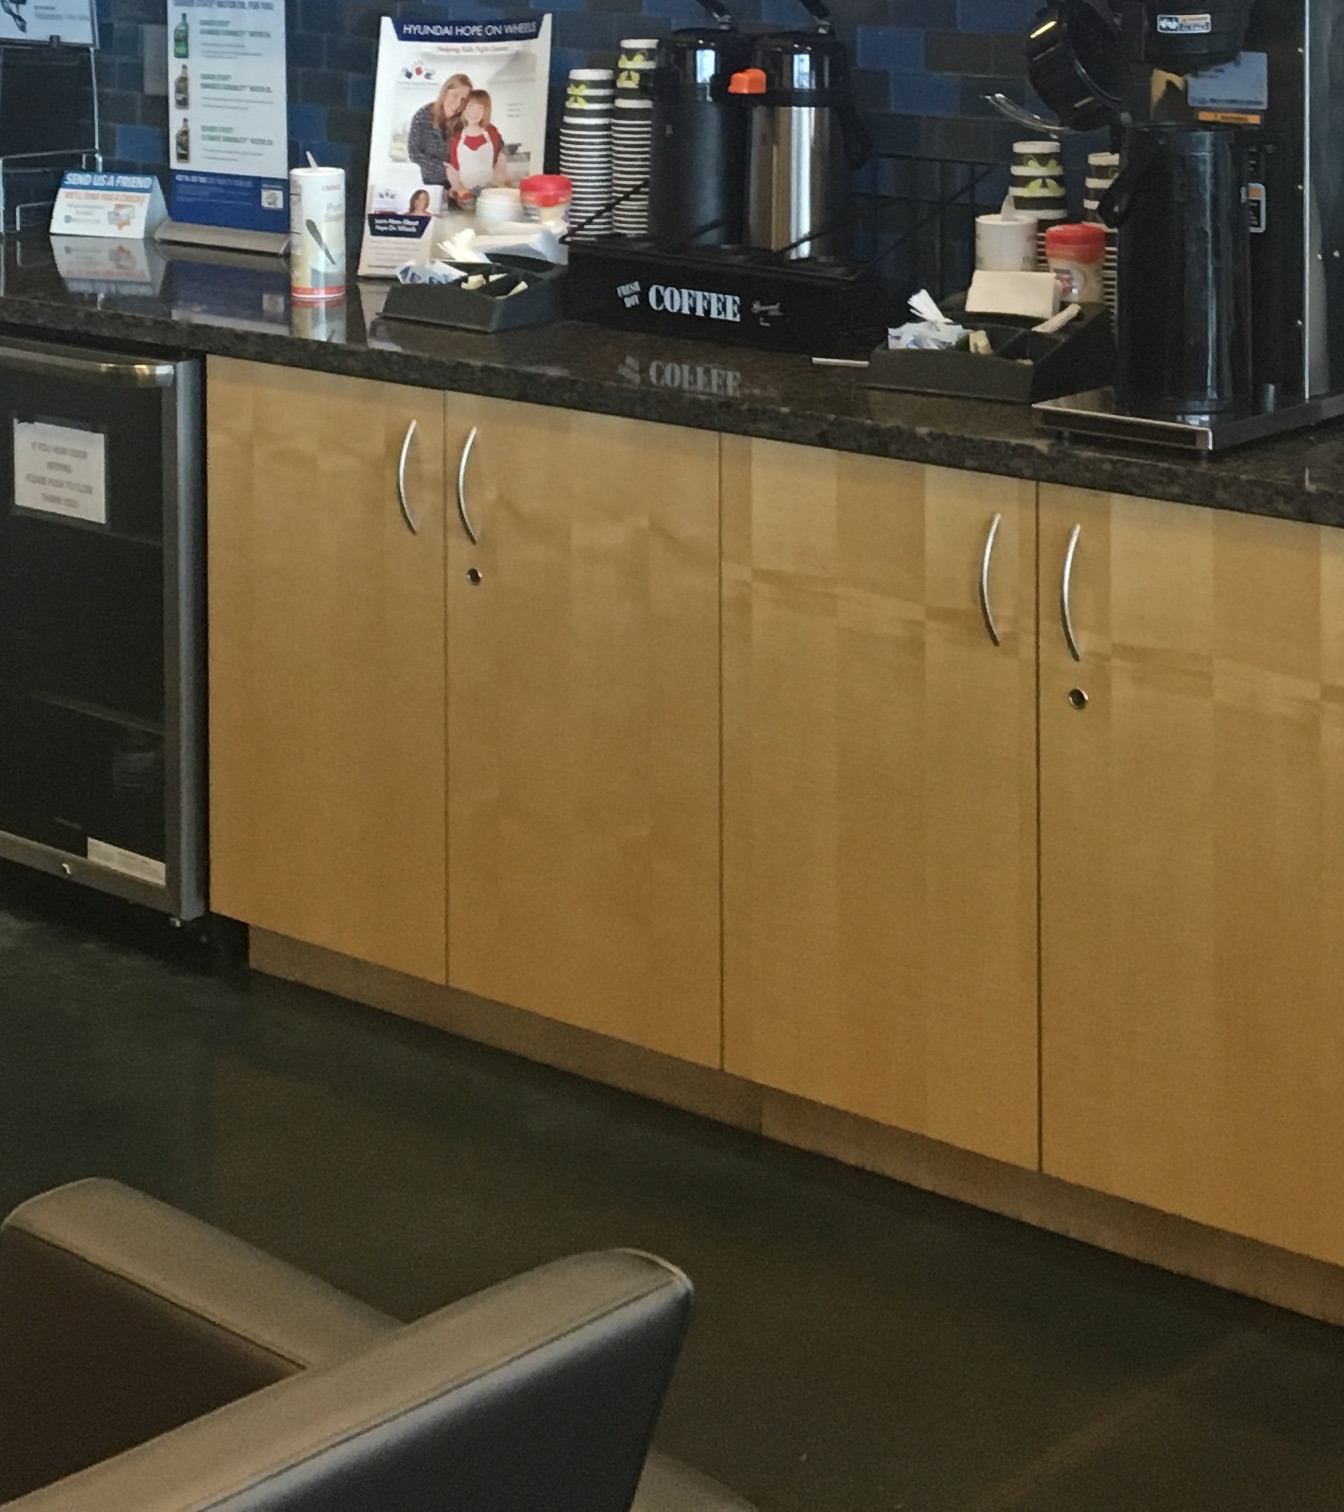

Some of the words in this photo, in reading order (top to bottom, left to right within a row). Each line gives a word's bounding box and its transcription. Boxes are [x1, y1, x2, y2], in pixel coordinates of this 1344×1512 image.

[403, 24, 453, 36] HYUNDAI
[455, 24, 483, 36] HOPE
[484, 23, 502, 36] ON
[504, 21, 537, 35] WHEELS
[63, 172, 92, 186] SEND
[92, 174, 108, 187] US
[106, 174, 115, 187] A
[116, 175, 153, 189] FRIEND
[648, 284, 741, 323] COFFEE
